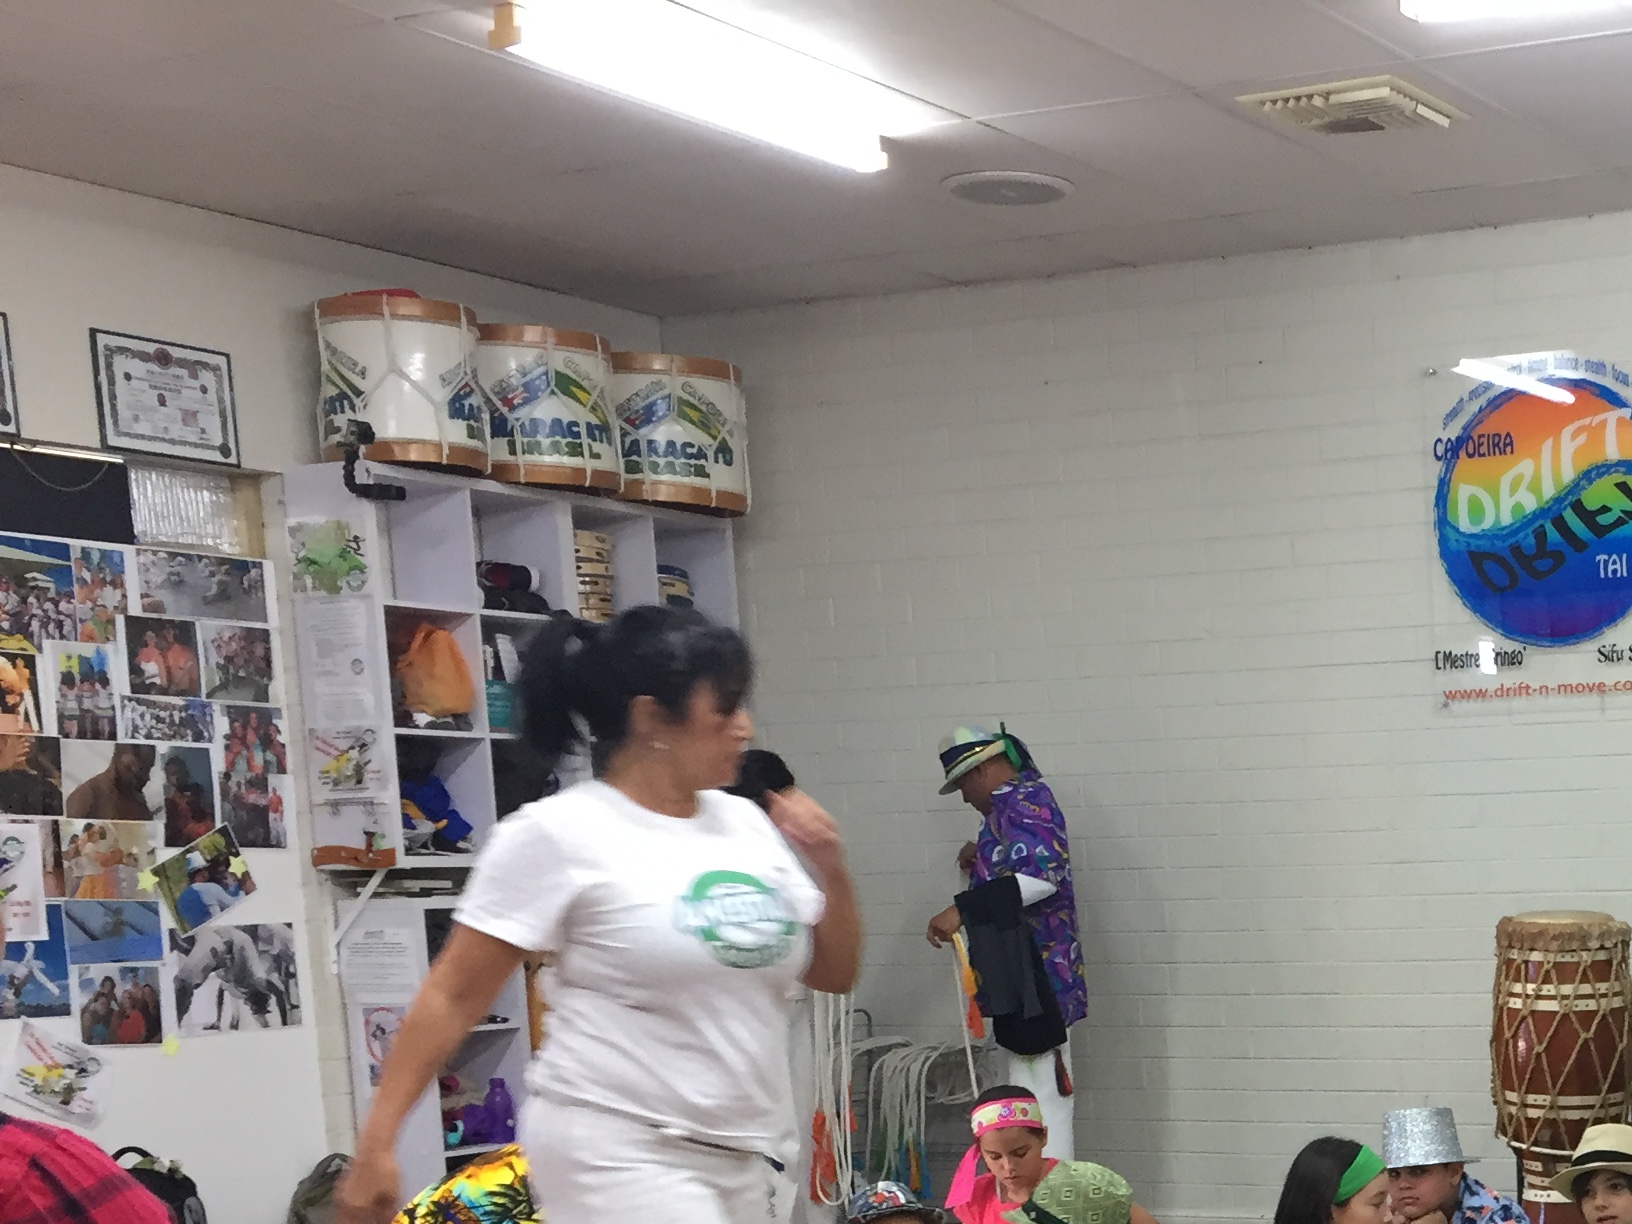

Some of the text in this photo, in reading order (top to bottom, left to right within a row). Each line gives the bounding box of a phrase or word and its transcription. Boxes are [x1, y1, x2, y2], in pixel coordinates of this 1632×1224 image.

[1433, 431, 1515, 462] CAPOEIRA
[1457, 407, 1632, 534] DRIFT
[1596, 553, 1628, 578] TAI
[1442, 649, 1480, 670] Mestre
[1597, 643, 1624, 663] Sifu
